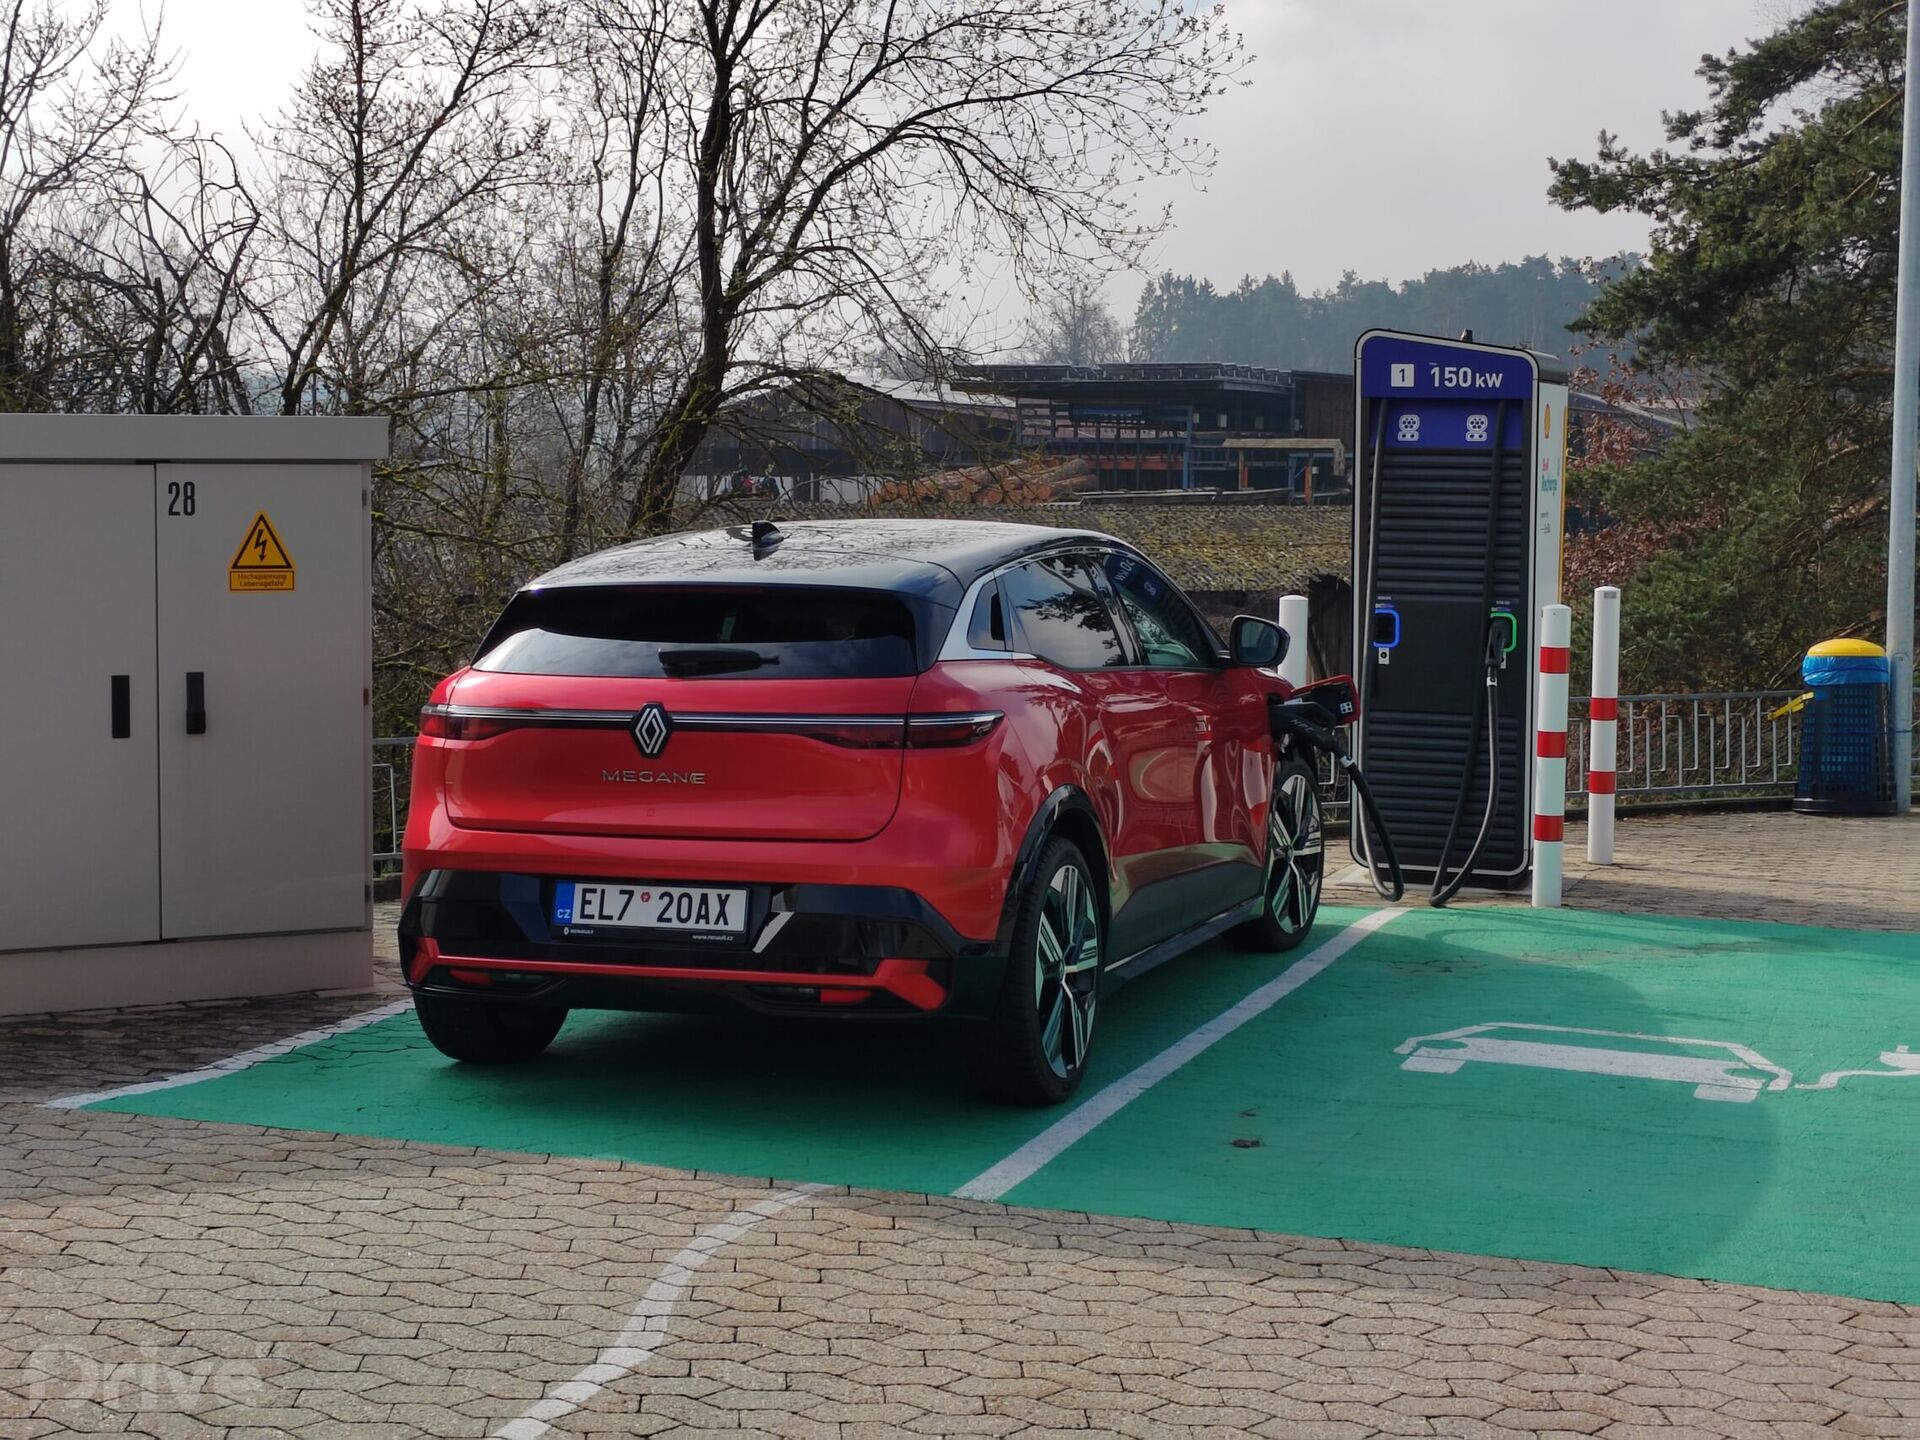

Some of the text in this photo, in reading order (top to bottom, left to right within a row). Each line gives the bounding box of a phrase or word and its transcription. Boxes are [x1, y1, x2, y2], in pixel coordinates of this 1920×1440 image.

[1398, 368, 1406, 383] 1
[1430, 366, 1503, 388] 150 kW
[168, 481, 195, 516] 28
[602, 770, 706, 784] MEGANE
[556, 909, 571, 919] CZ
[579, 888, 731, 926] EL7 20AX
